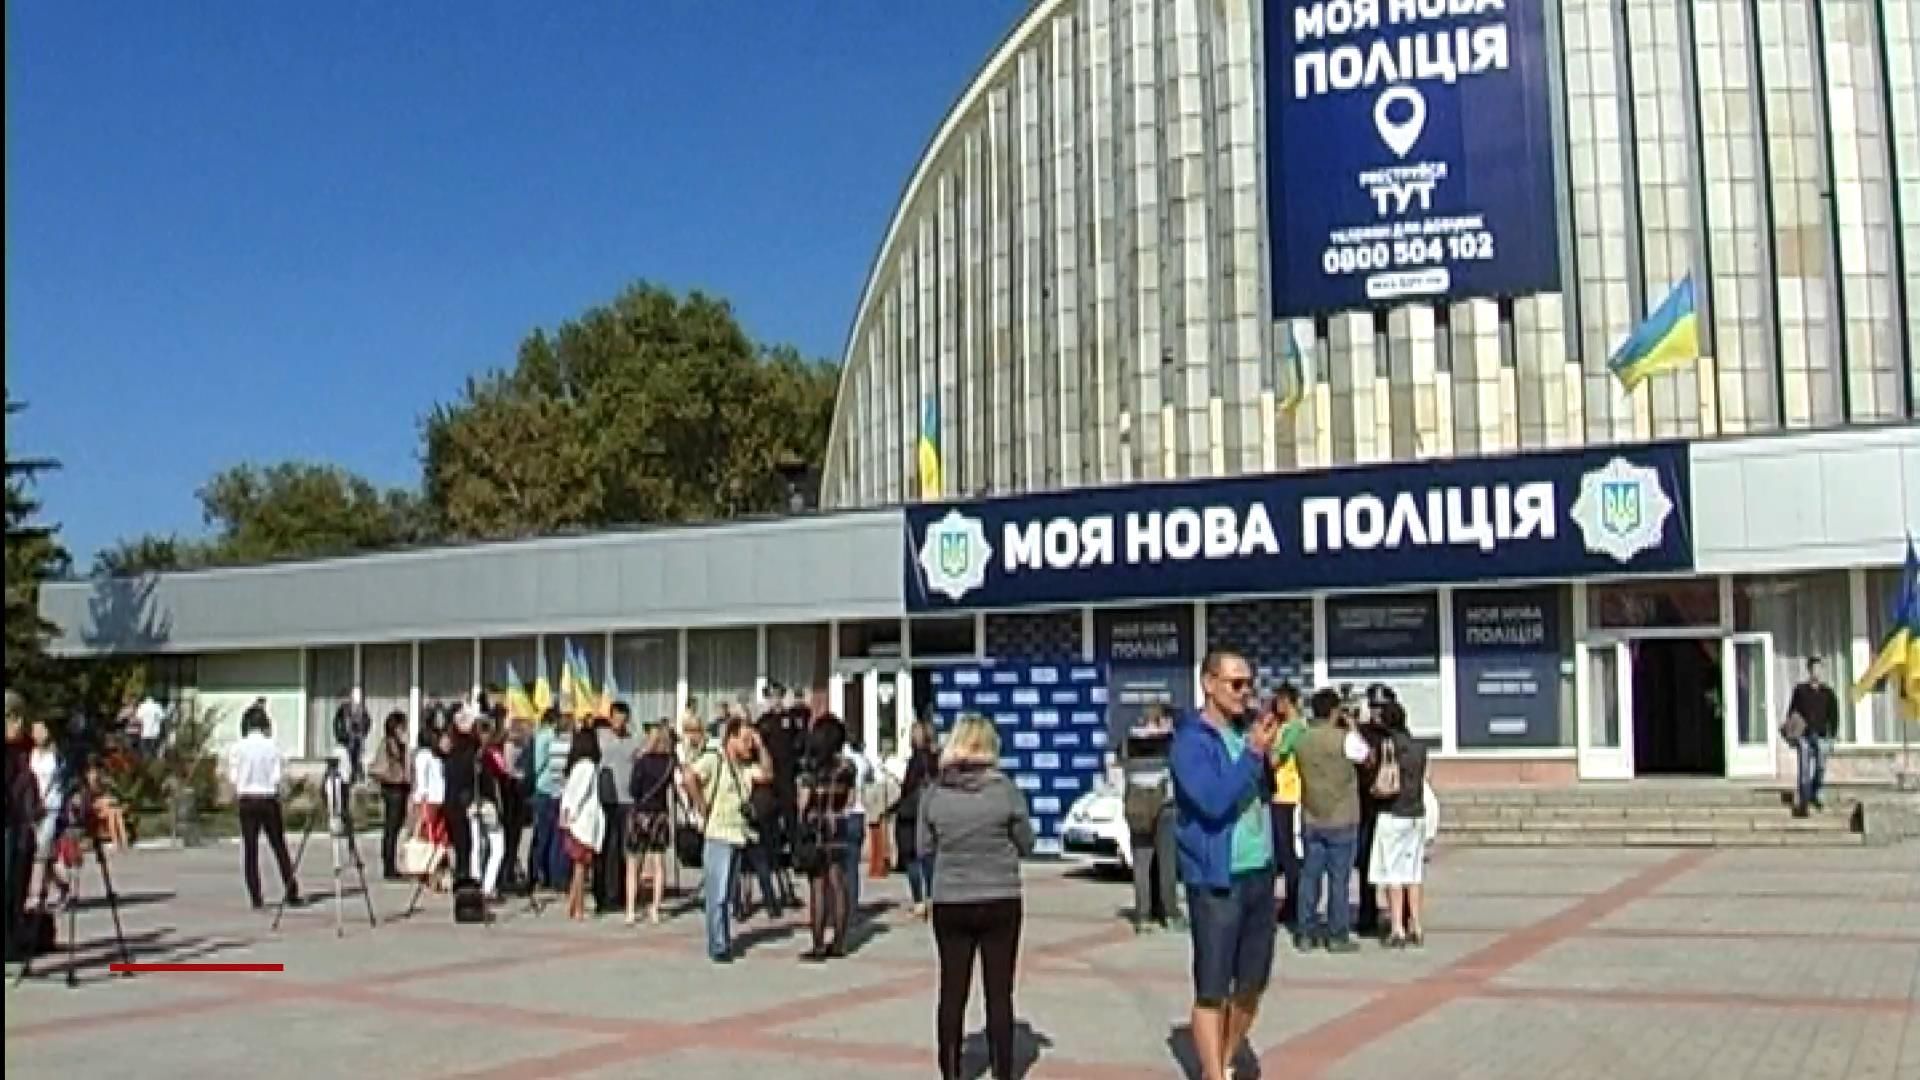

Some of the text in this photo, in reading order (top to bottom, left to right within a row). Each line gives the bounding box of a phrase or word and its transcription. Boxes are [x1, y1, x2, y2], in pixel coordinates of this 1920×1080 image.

[1295, 0, 1379, 43] МОЯ
[1295, 23, 1509, 98] ПОЛІЦІЯ
[1371, 180, 1436, 216] ТУТ
[1393, 236, 1443, 264] 504
[1447, 231, 1493, 260] 102
[1004, 481, 1555, 571] МОЯ НОВА ПОЛІЦІЯ
